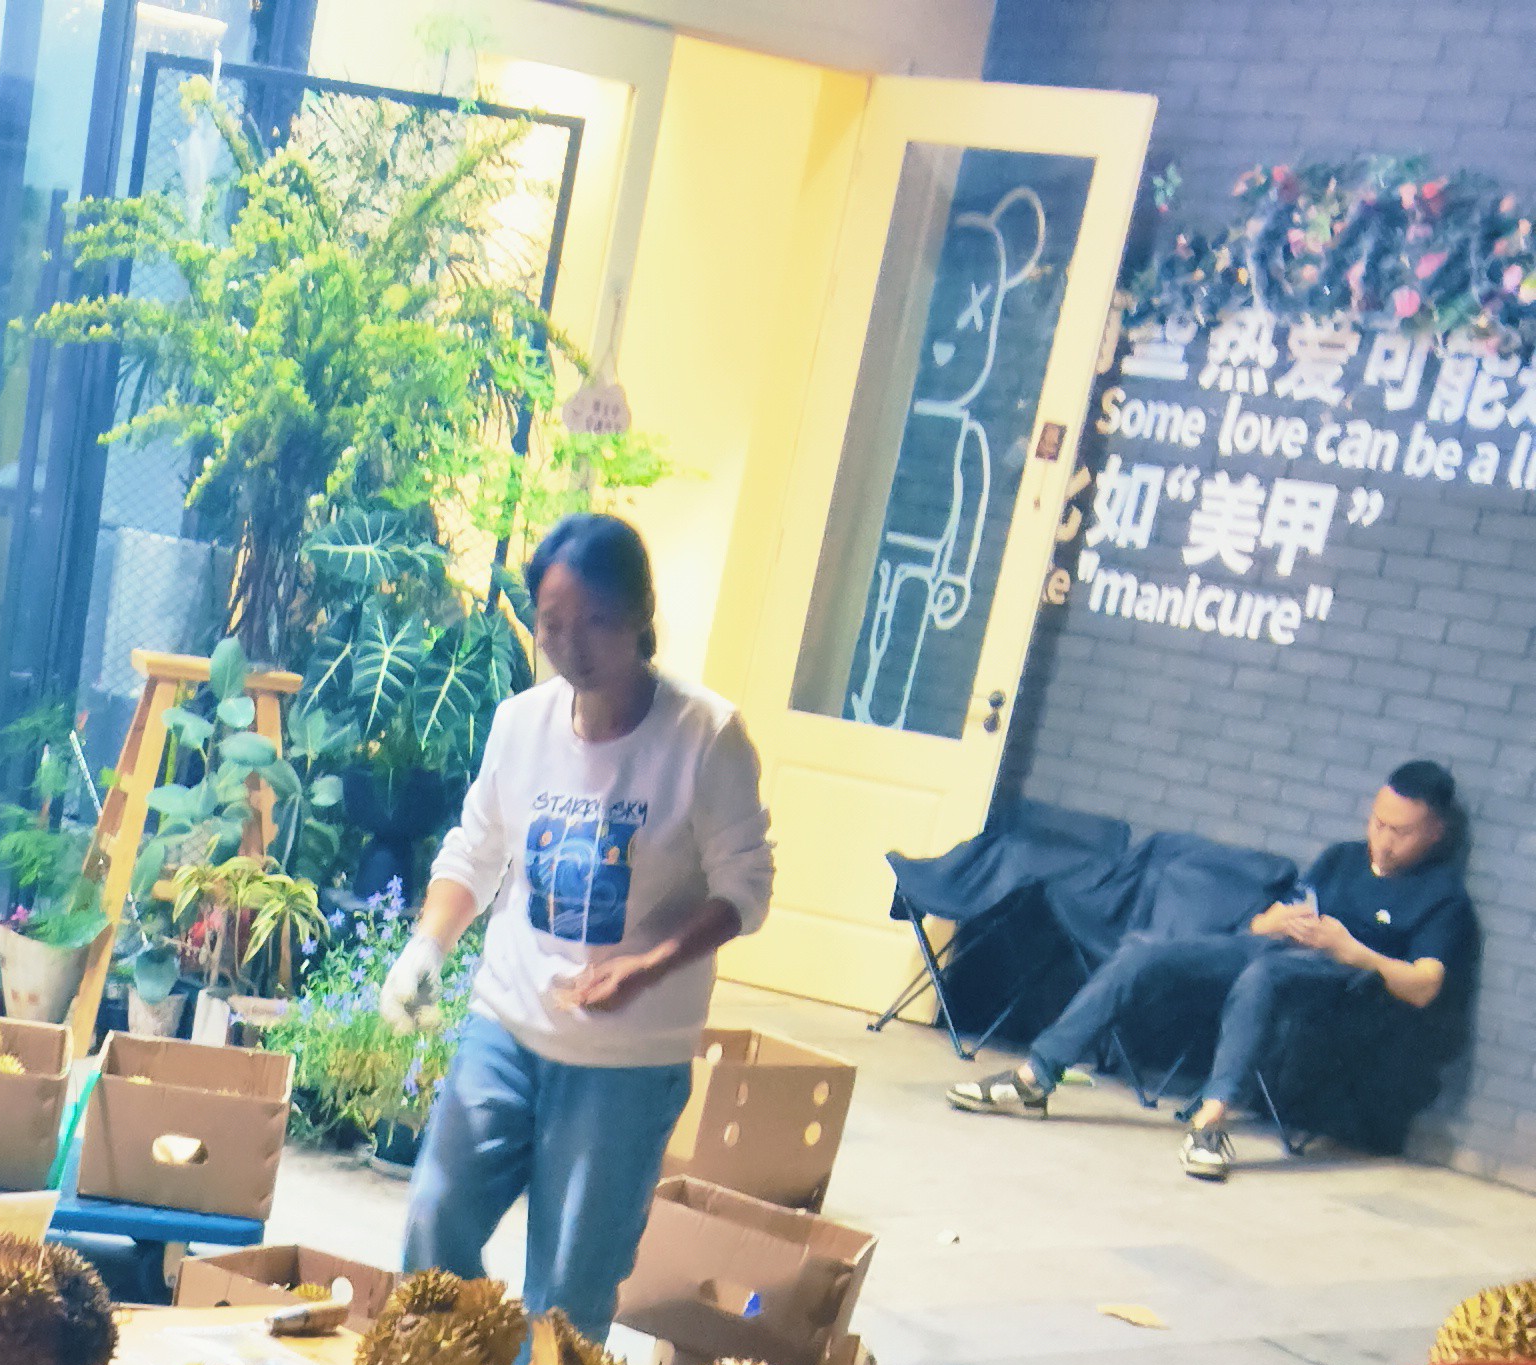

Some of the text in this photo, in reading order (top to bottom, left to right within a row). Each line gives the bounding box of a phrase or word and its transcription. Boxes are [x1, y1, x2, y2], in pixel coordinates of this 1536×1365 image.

[1096, 387, 1206, 449] Some
[1218, 392, 1309, 459] love
[1315, 418, 1399, 472] can
[1402, 420, 1463, 481] be
[1467, 441, 1500, 485] a
[1077, 548, 1334, 645] "manicure"
